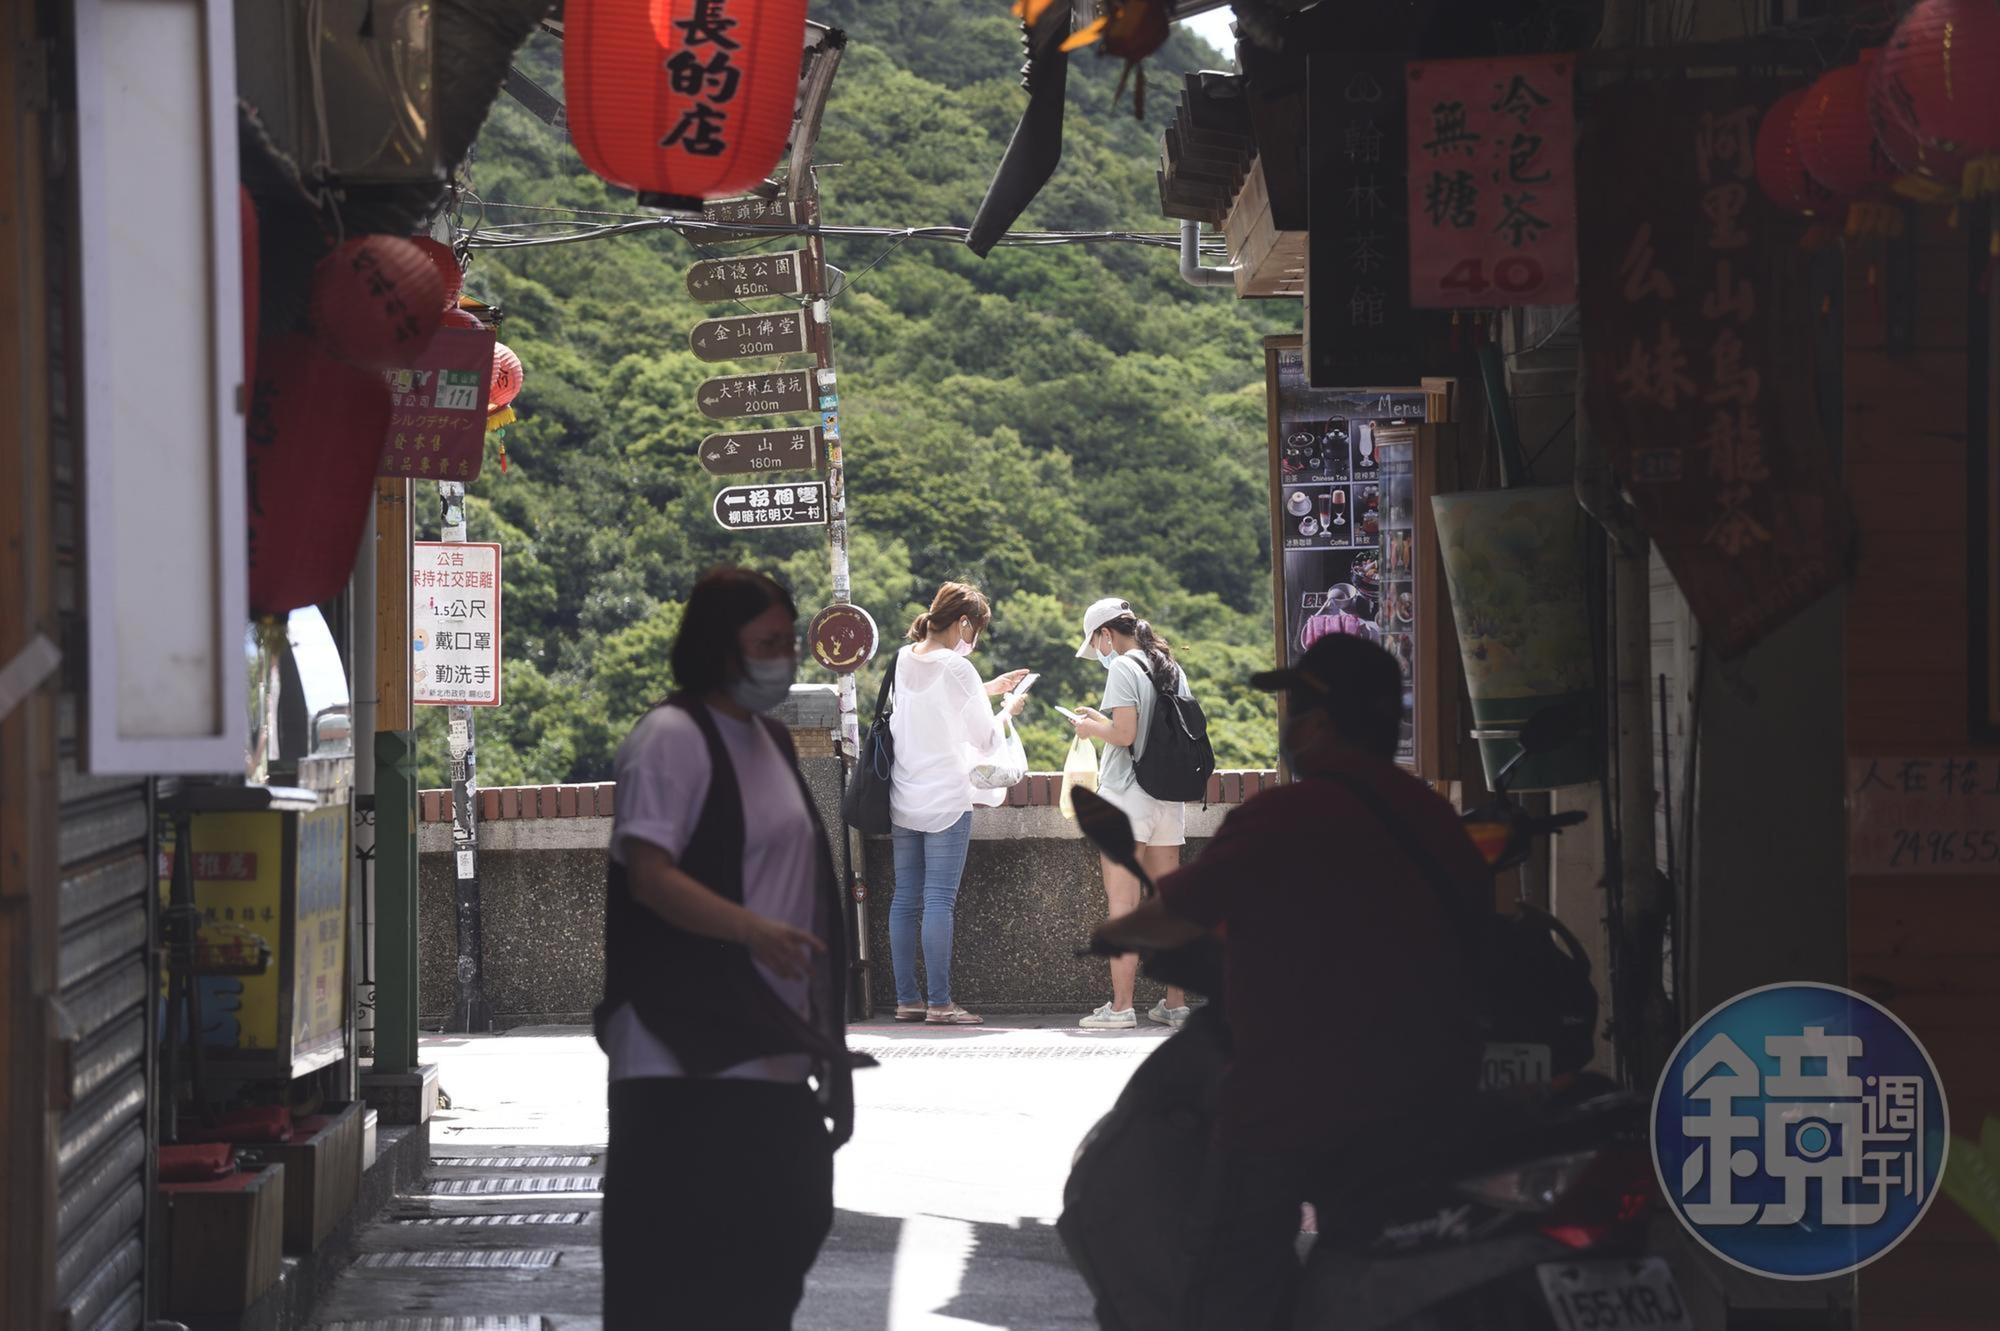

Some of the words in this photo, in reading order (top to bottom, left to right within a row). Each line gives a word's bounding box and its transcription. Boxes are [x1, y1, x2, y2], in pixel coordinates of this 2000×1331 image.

[1422, 101, 1482, 229] 無糖
[1490, 74, 1552, 248] 冷泡茶
[1343, 119, 1386, 329] 翰林茶館
[708, 258, 790, 282] 頌德公園
[1439, 255, 1544, 296] 40
[733, 282, 768, 295] 450m
[712, 316, 796, 343] 金山佛堂
[738, 341, 774, 354] 300m
[449, 388, 473, 407] 171
[744, 400, 779, 413] 200m
[1377, 394, 1424, 417] Menu
[722, 434, 806, 456] 金山岩
[749, 457, 782, 470] 180m
[748, 486, 819, 508] 拐個彎
[728, 505, 821, 524] 柳暗花明又一村
[436, 552, 465, 567] 公告
[413, 570, 494, 589] 保持社交距離
[433, 599, 487, 619] 1.5公尺
[435, 631, 491, 651] 戴口罩
[435, 664, 491, 684] 勤洗手
[429, 689, 466, 698] 新北市政府
